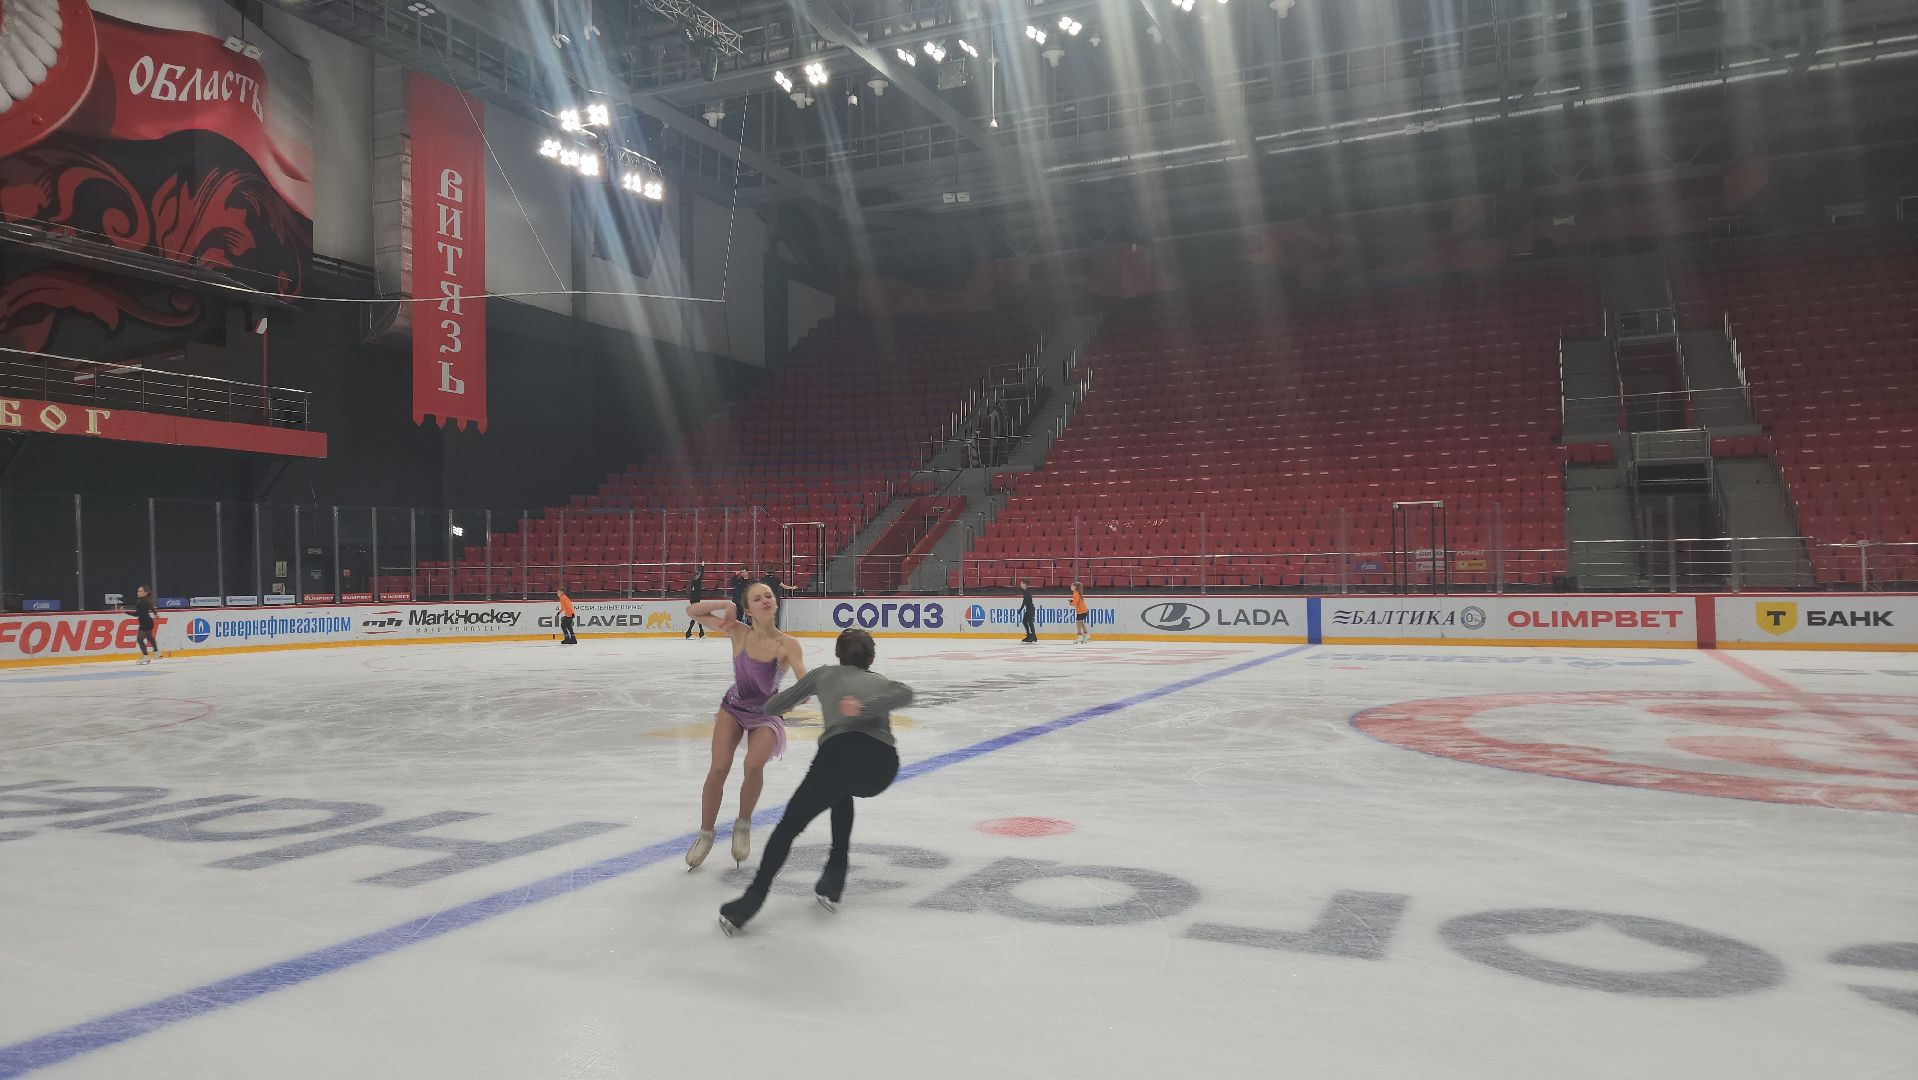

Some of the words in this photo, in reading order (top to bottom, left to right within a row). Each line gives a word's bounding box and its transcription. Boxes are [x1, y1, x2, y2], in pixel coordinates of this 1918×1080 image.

[437, 168, 465, 395] ВИТЯЗЬ
[408, 608, 521, 627] MarkHockey
[537, 614, 643, 628] GILAVED
[1217, 608, 1290, 626] LADA
[1350, 610, 1456, 626] БАЛТИКА
[1507, 610, 1683, 628] OLIMPBET
[1807, 610, 1895, 627] БАНК
[215, 615, 351, 640] севернефтегазпром
